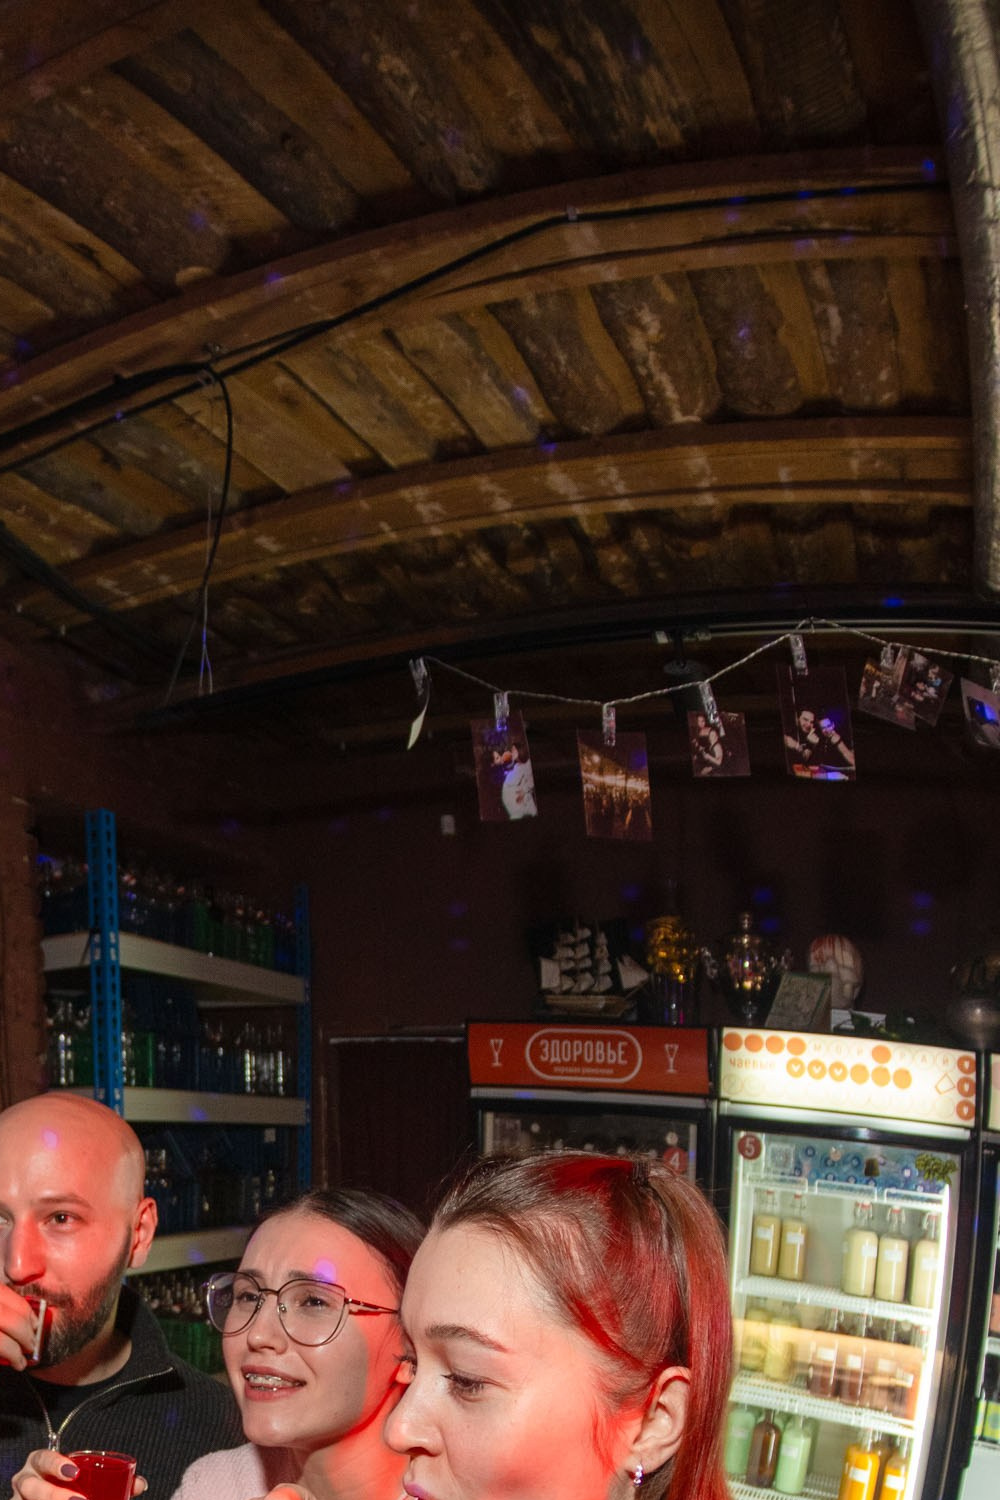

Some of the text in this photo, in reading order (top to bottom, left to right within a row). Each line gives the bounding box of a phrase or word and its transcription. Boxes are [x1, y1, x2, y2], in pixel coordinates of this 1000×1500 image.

[539, 1039, 629, 1066] ЗДОРОВЬЕ
[745, 1134, 756, 1156] 5
[669, 1150, 680, 1170] 4
